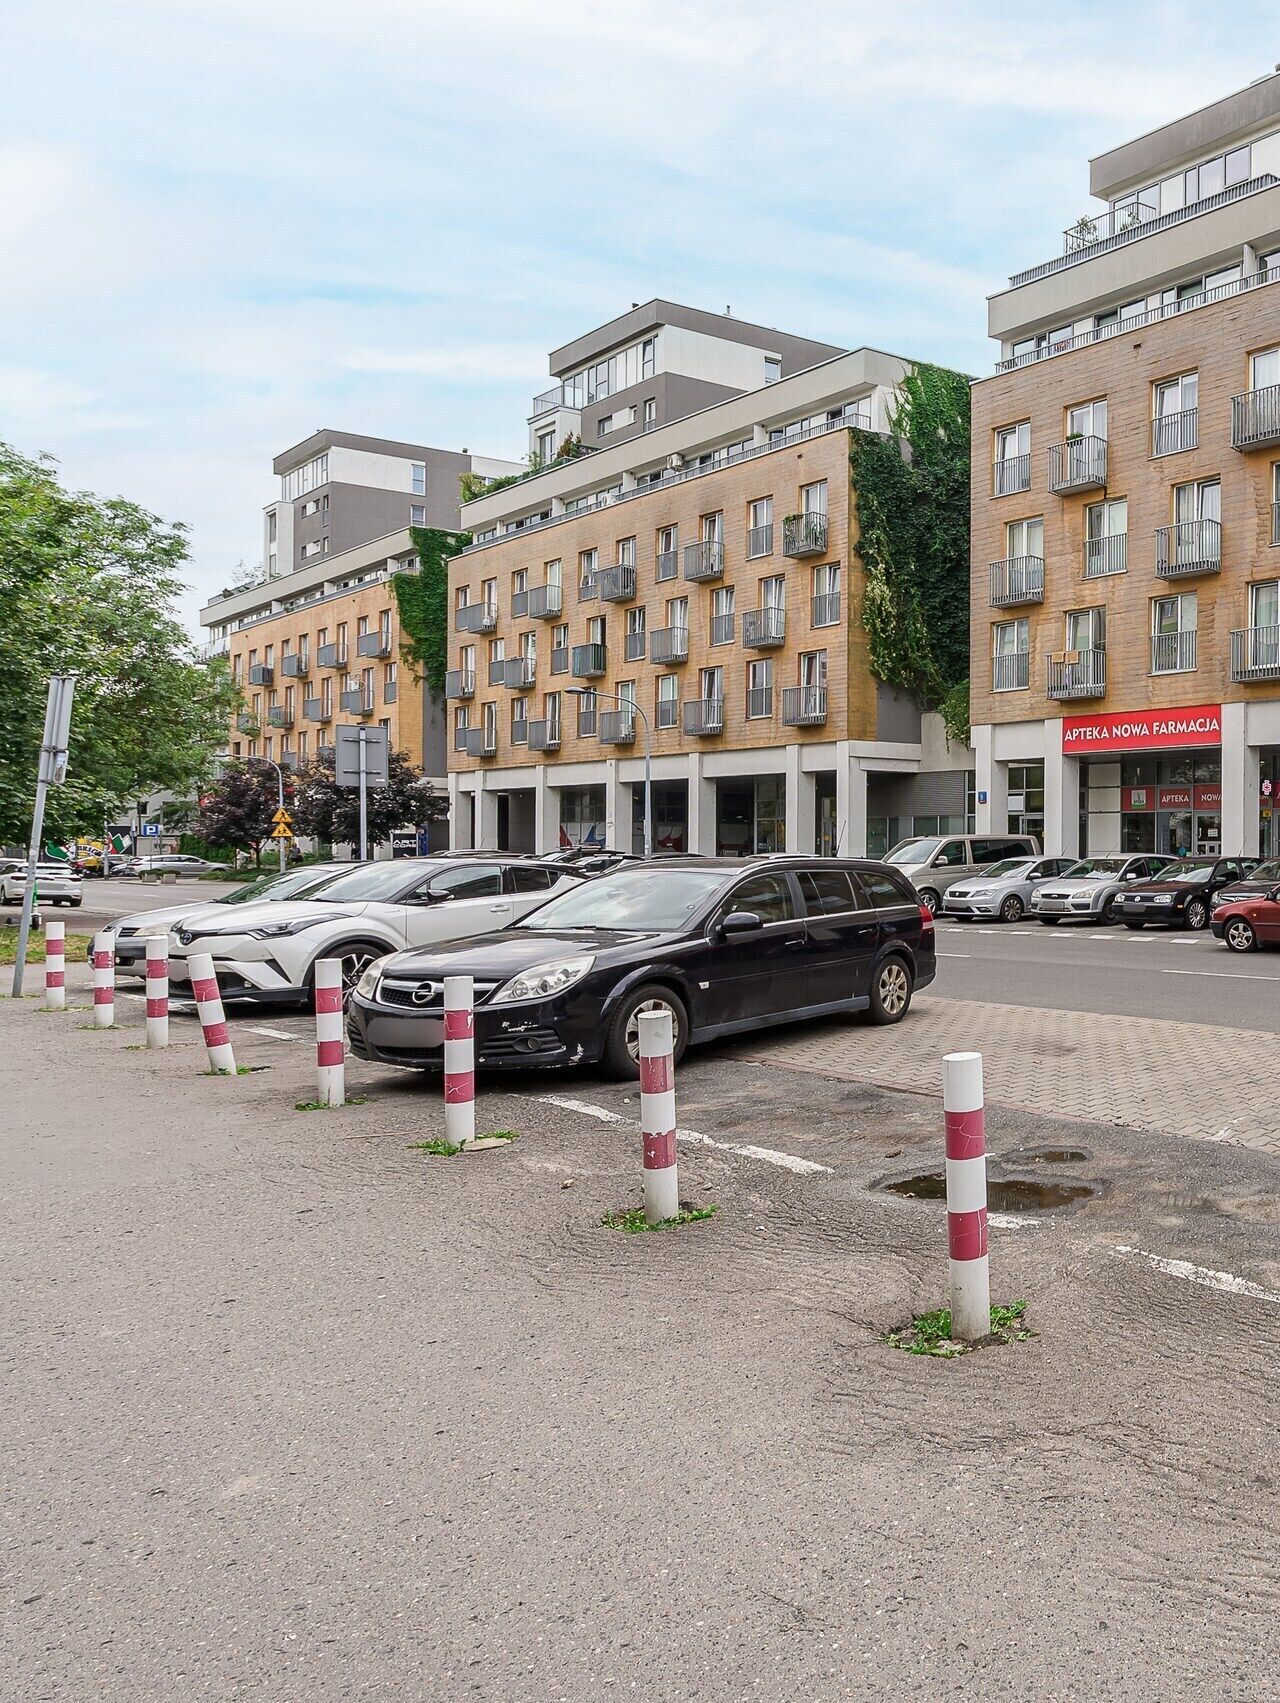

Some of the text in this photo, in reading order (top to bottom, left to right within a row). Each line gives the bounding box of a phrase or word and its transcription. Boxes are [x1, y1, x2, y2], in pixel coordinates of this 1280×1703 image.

[1064, 717, 1220, 742] APTEKA NOWA FARMACJA
[1161, 794, 1189, 803] APTEKA
